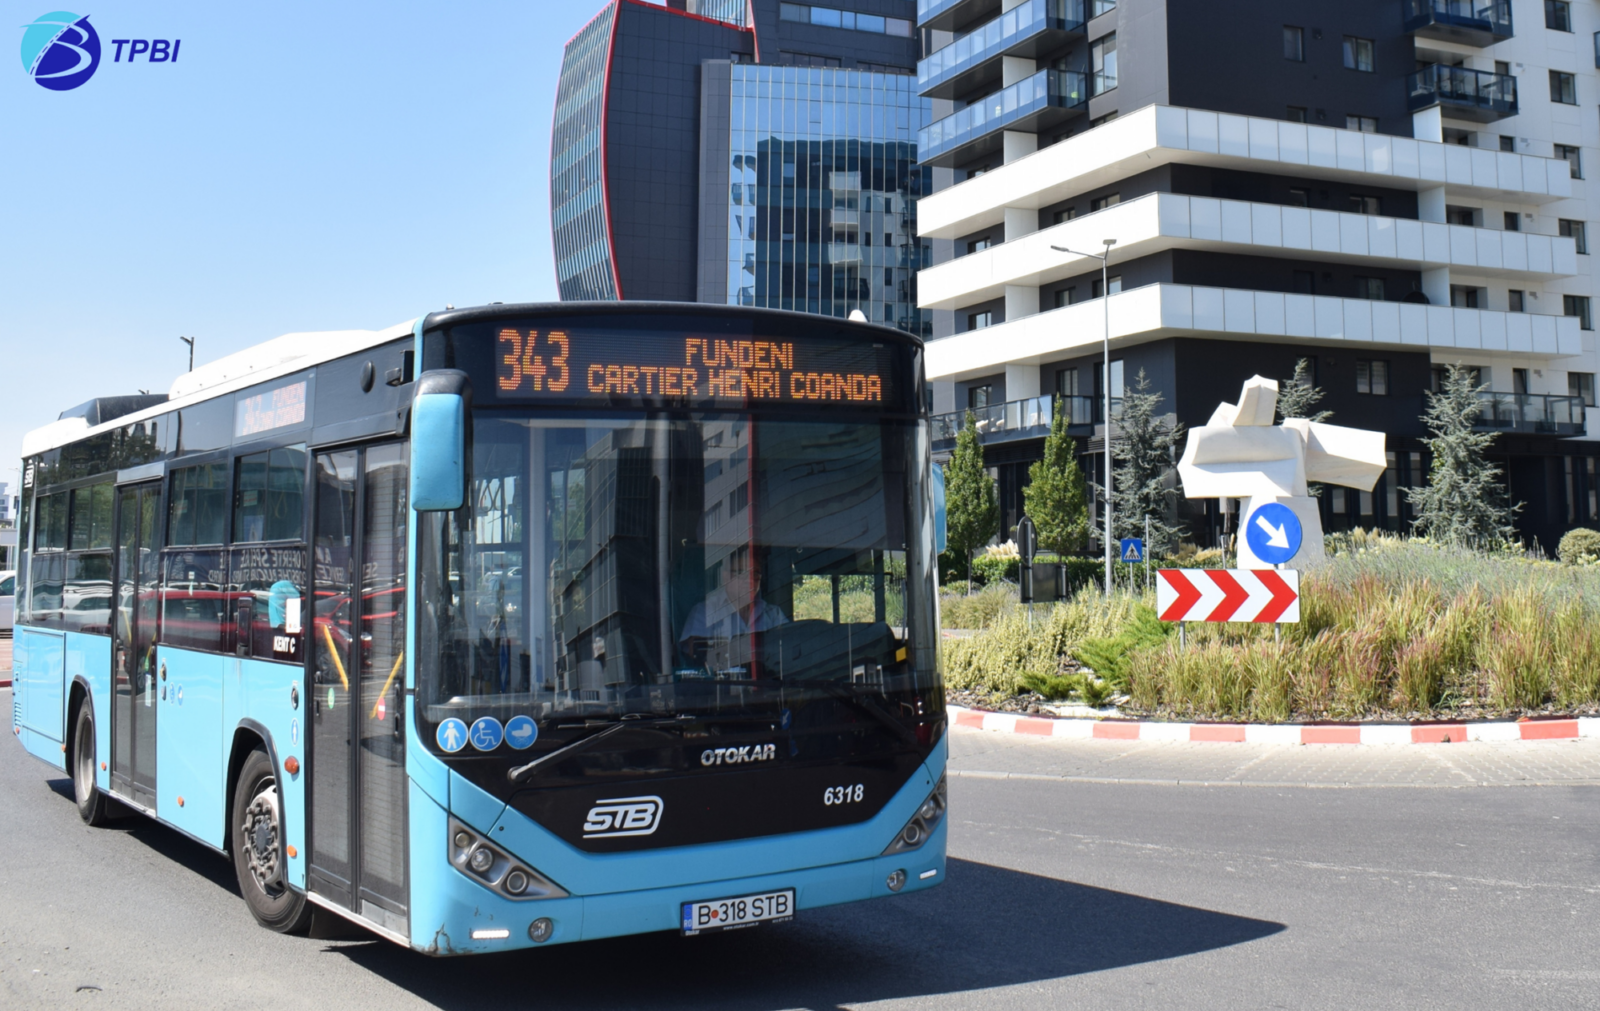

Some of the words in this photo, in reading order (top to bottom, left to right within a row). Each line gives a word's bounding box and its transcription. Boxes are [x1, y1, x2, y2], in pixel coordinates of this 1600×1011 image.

[499, 329, 569, 391] 343
[686, 338, 793, 369] FUNDENI
[587, 364, 698, 396] CARTIER
[708, 369, 781, 399] HENRI
[790, 372, 882, 401] COANDA
[273, 636, 290, 653] KENT
[290, 637, 297, 654] C
[701, 744, 776, 766] OTOKAR
[824, 784, 865, 806] 6318
[583, 802, 657, 832] STB
[698, 905, 712, 926] B
[719, 900, 747, 922] 318
[752, 894, 788, 918] STB
